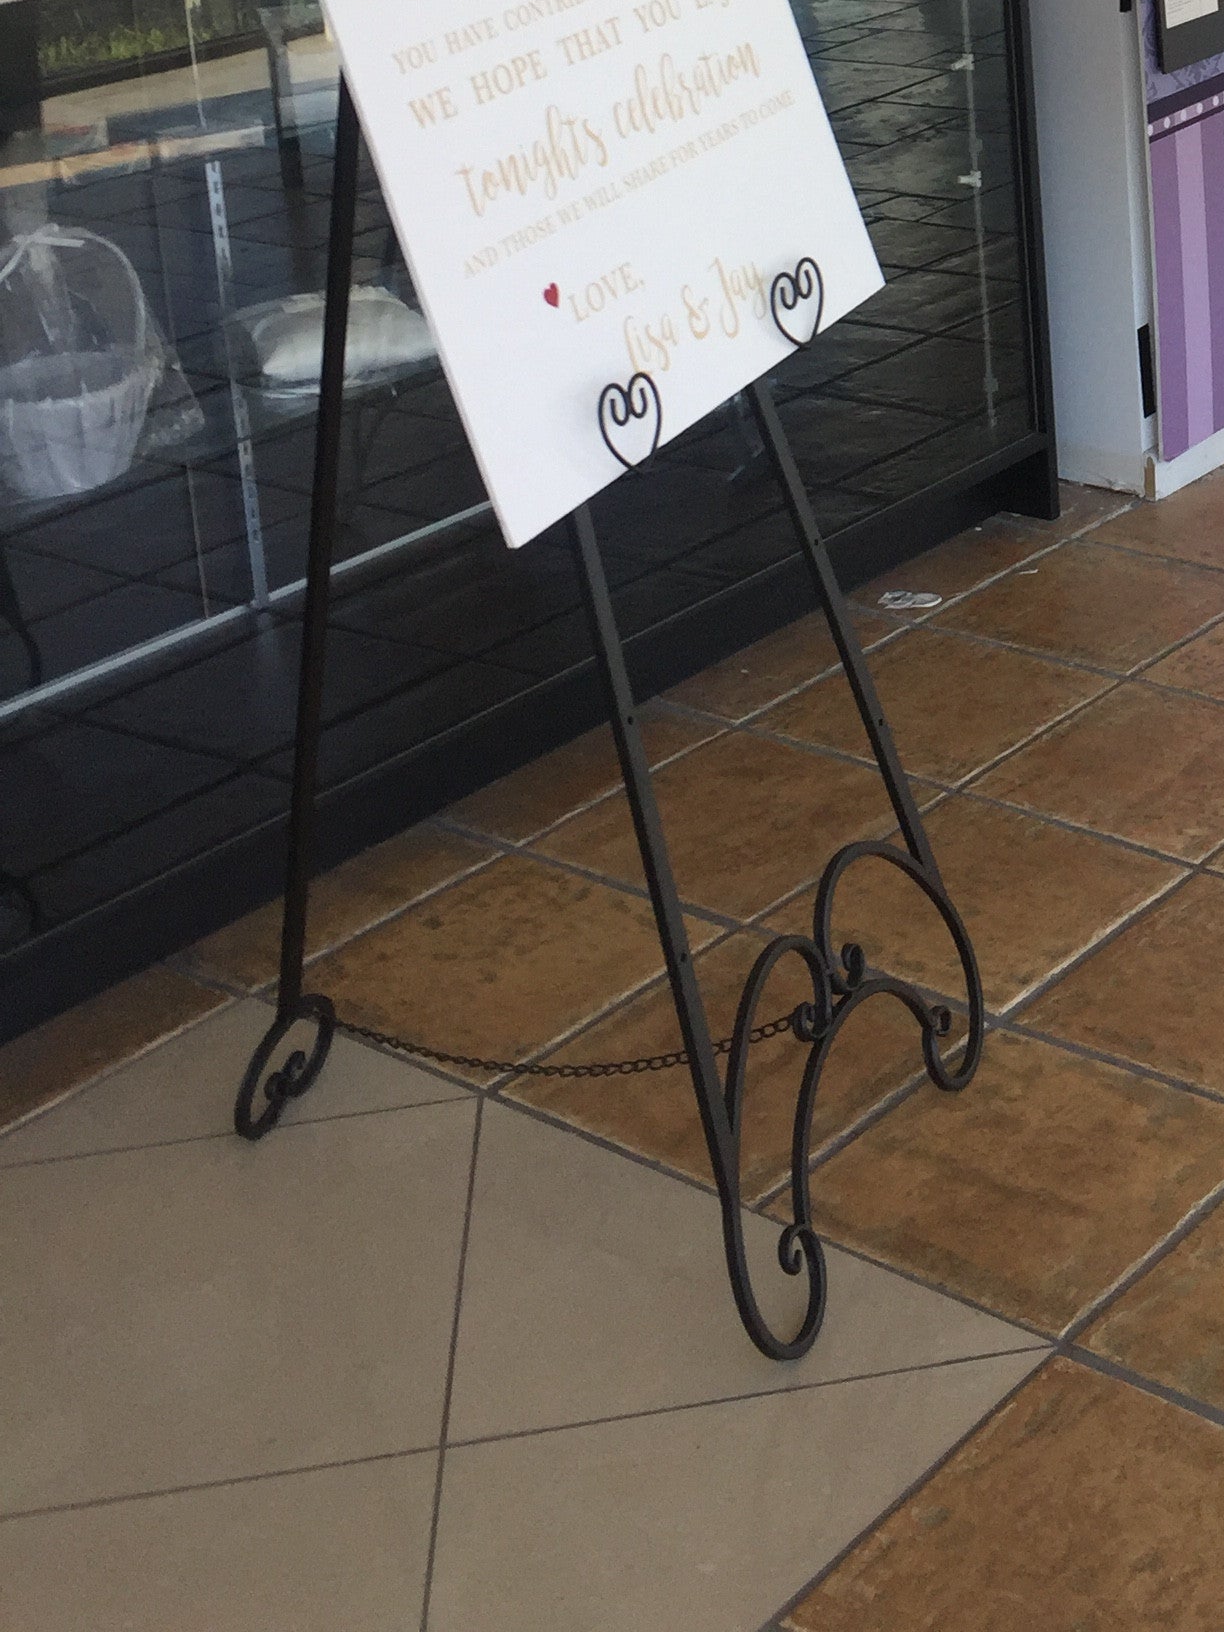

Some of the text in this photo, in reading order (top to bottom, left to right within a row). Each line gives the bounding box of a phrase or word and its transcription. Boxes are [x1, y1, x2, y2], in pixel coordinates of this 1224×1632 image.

[392, 39, 439, 75] YOU
[444, 16, 500, 56] HAVE
[407, 85, 460, 130] WE
[469, 49, 549, 106] HOPE
[556, 16, 625, 67] THAT
[612, 41, 762, 139] celebration
[681, 284, 711, 339] &
[708, 257, 768, 339] Jay
